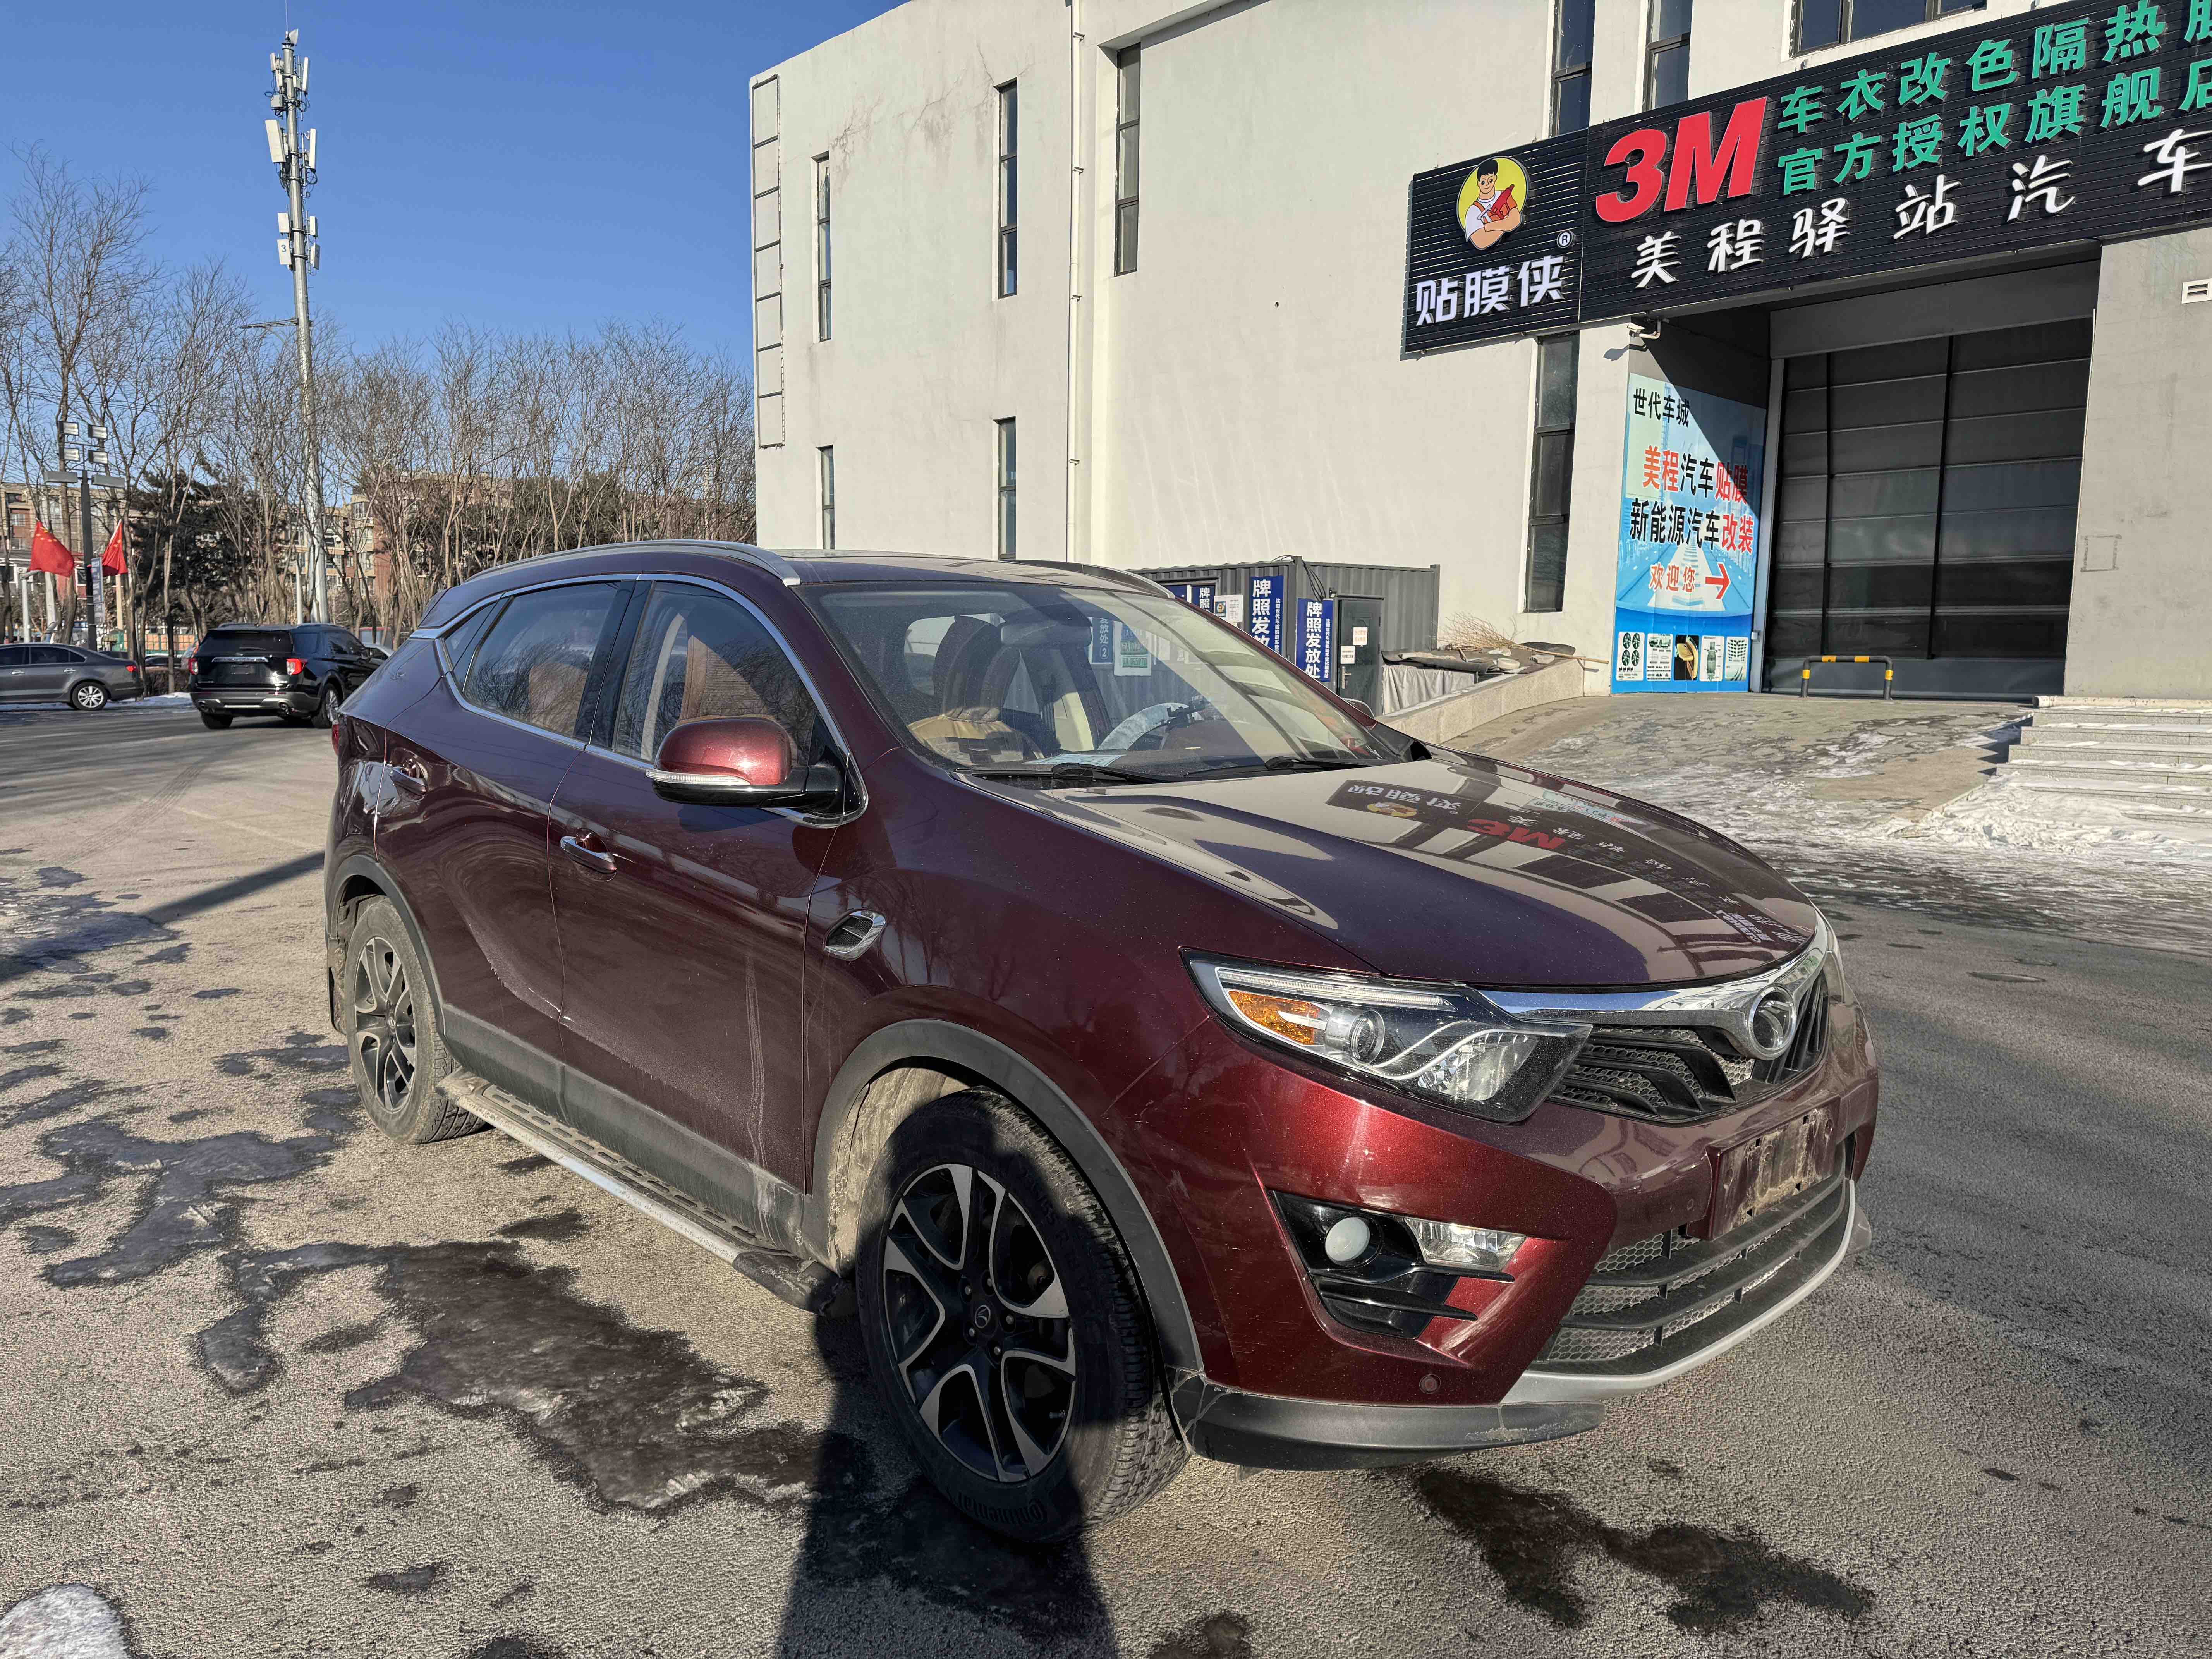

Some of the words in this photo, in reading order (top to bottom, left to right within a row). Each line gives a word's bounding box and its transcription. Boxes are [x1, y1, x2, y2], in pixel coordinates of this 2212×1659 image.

[1596, 96, 1769, 222] 3M
[1416, 255, 1566, 326] 贴膜侠
[1633, 388, 1690, 428] 世代车城
[1642, 445, 1748, 504] 美程汽车贴膜
[1629, 498, 1754, 554] 新能源汽车改装
[1200, 587, 1210, 612] 牌照
[1649, 563, 1695, 592] 欢迎您
[1305, 602, 1322, 679] 牌照发放处
